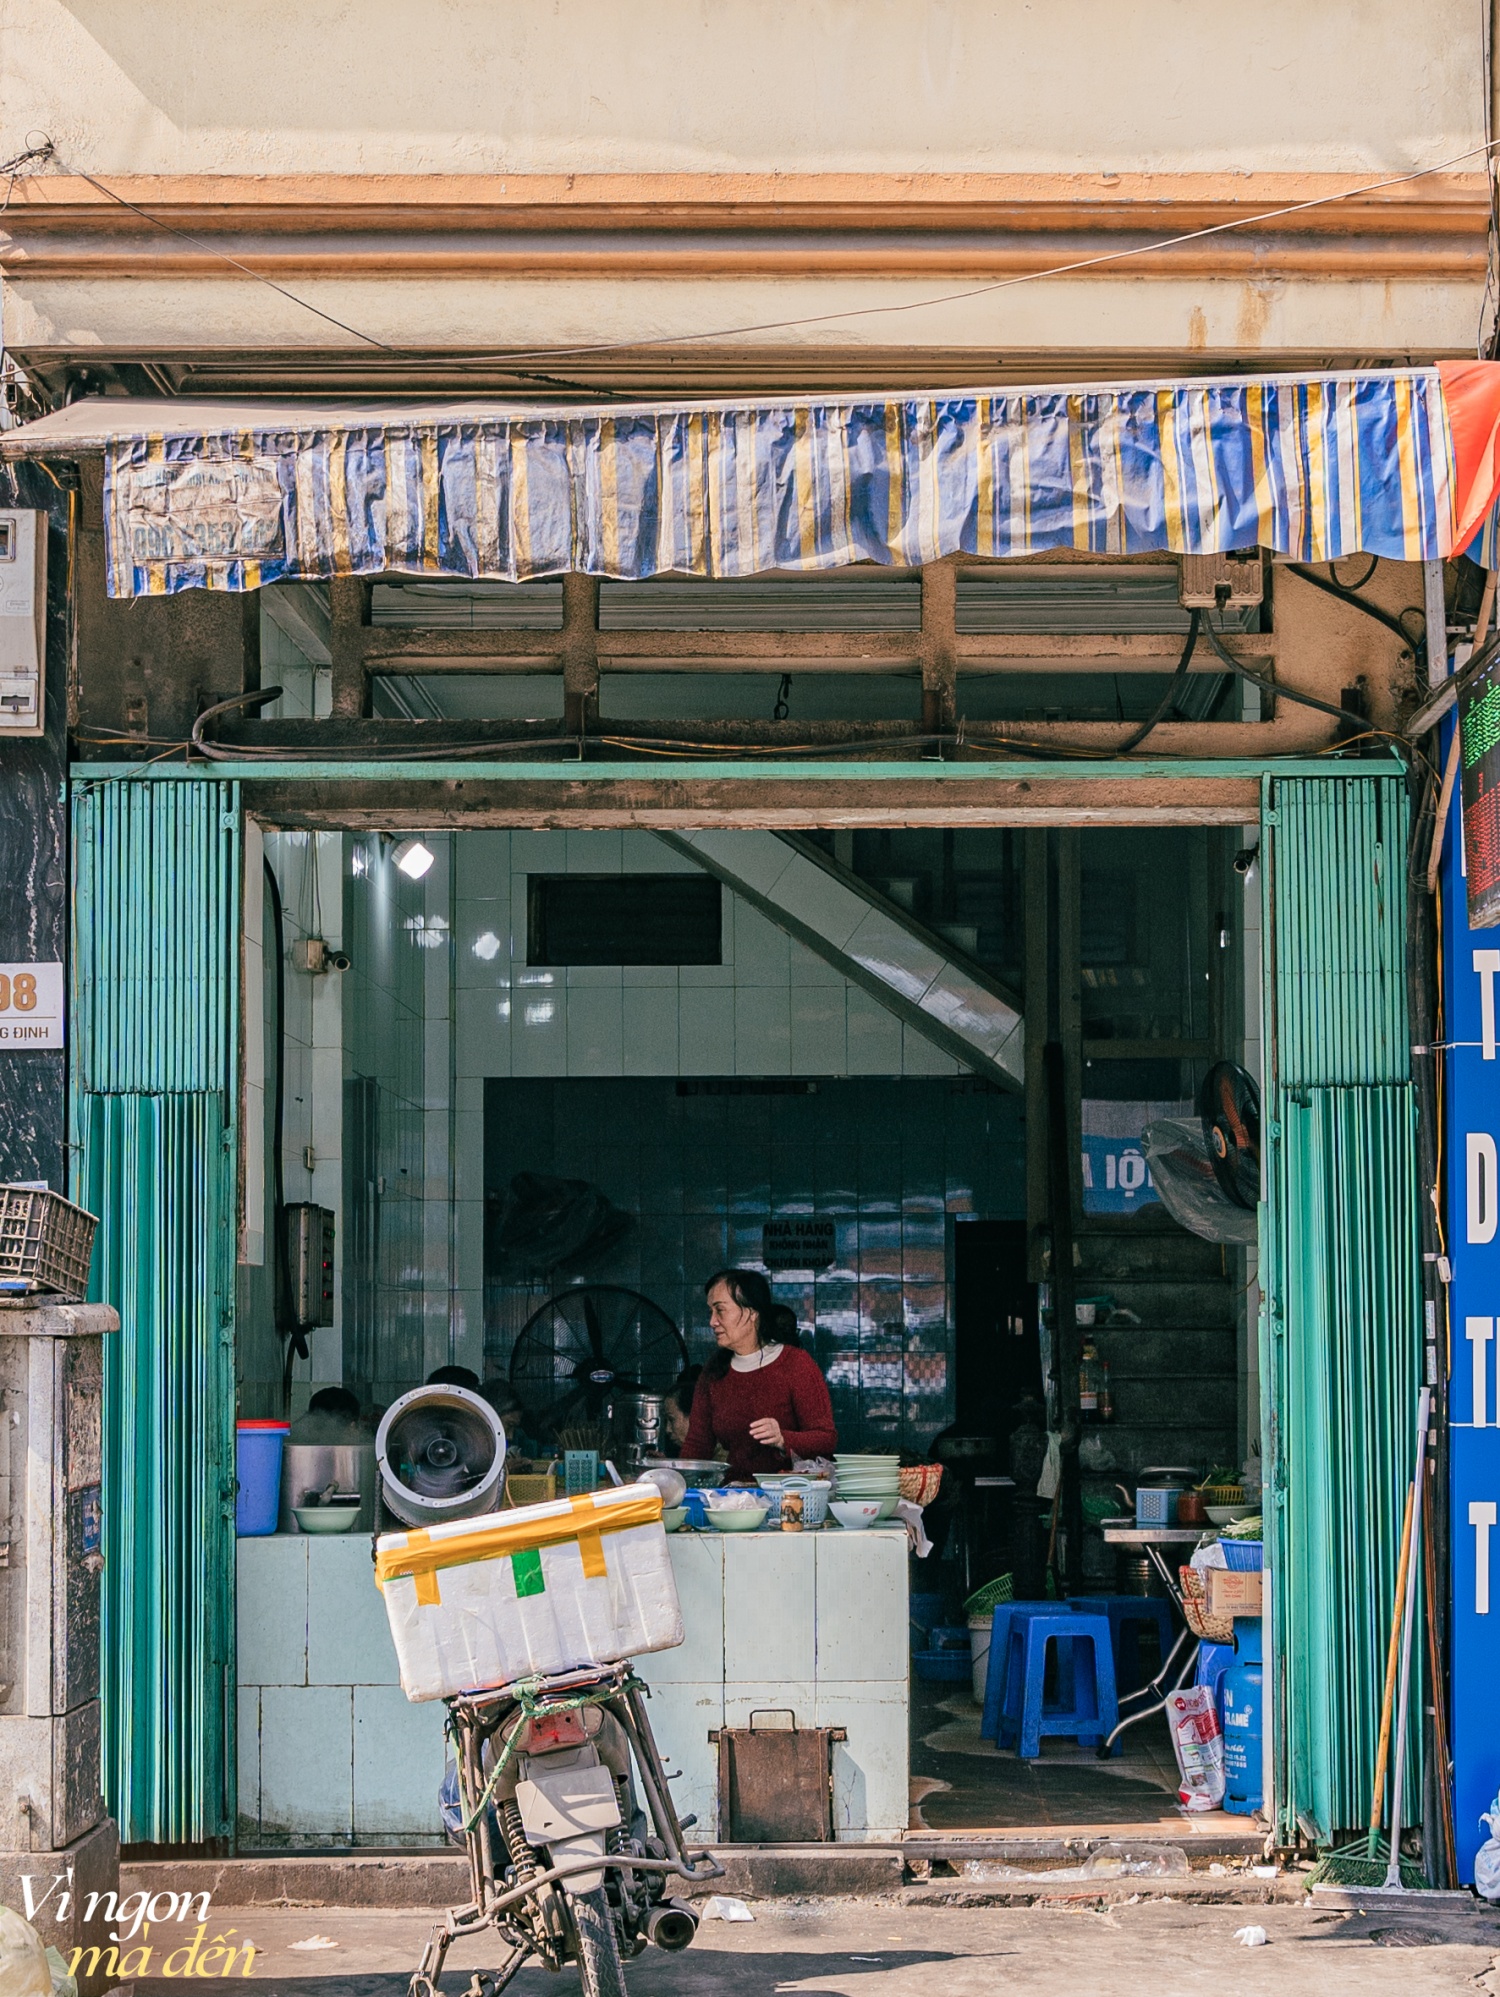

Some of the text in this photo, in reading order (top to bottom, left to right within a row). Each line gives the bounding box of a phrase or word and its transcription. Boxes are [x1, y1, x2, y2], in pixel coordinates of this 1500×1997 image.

[13, 1026, 48, 1041] ĐỊNH
[763, 1220, 833, 1236] NHÀ HÀNG
